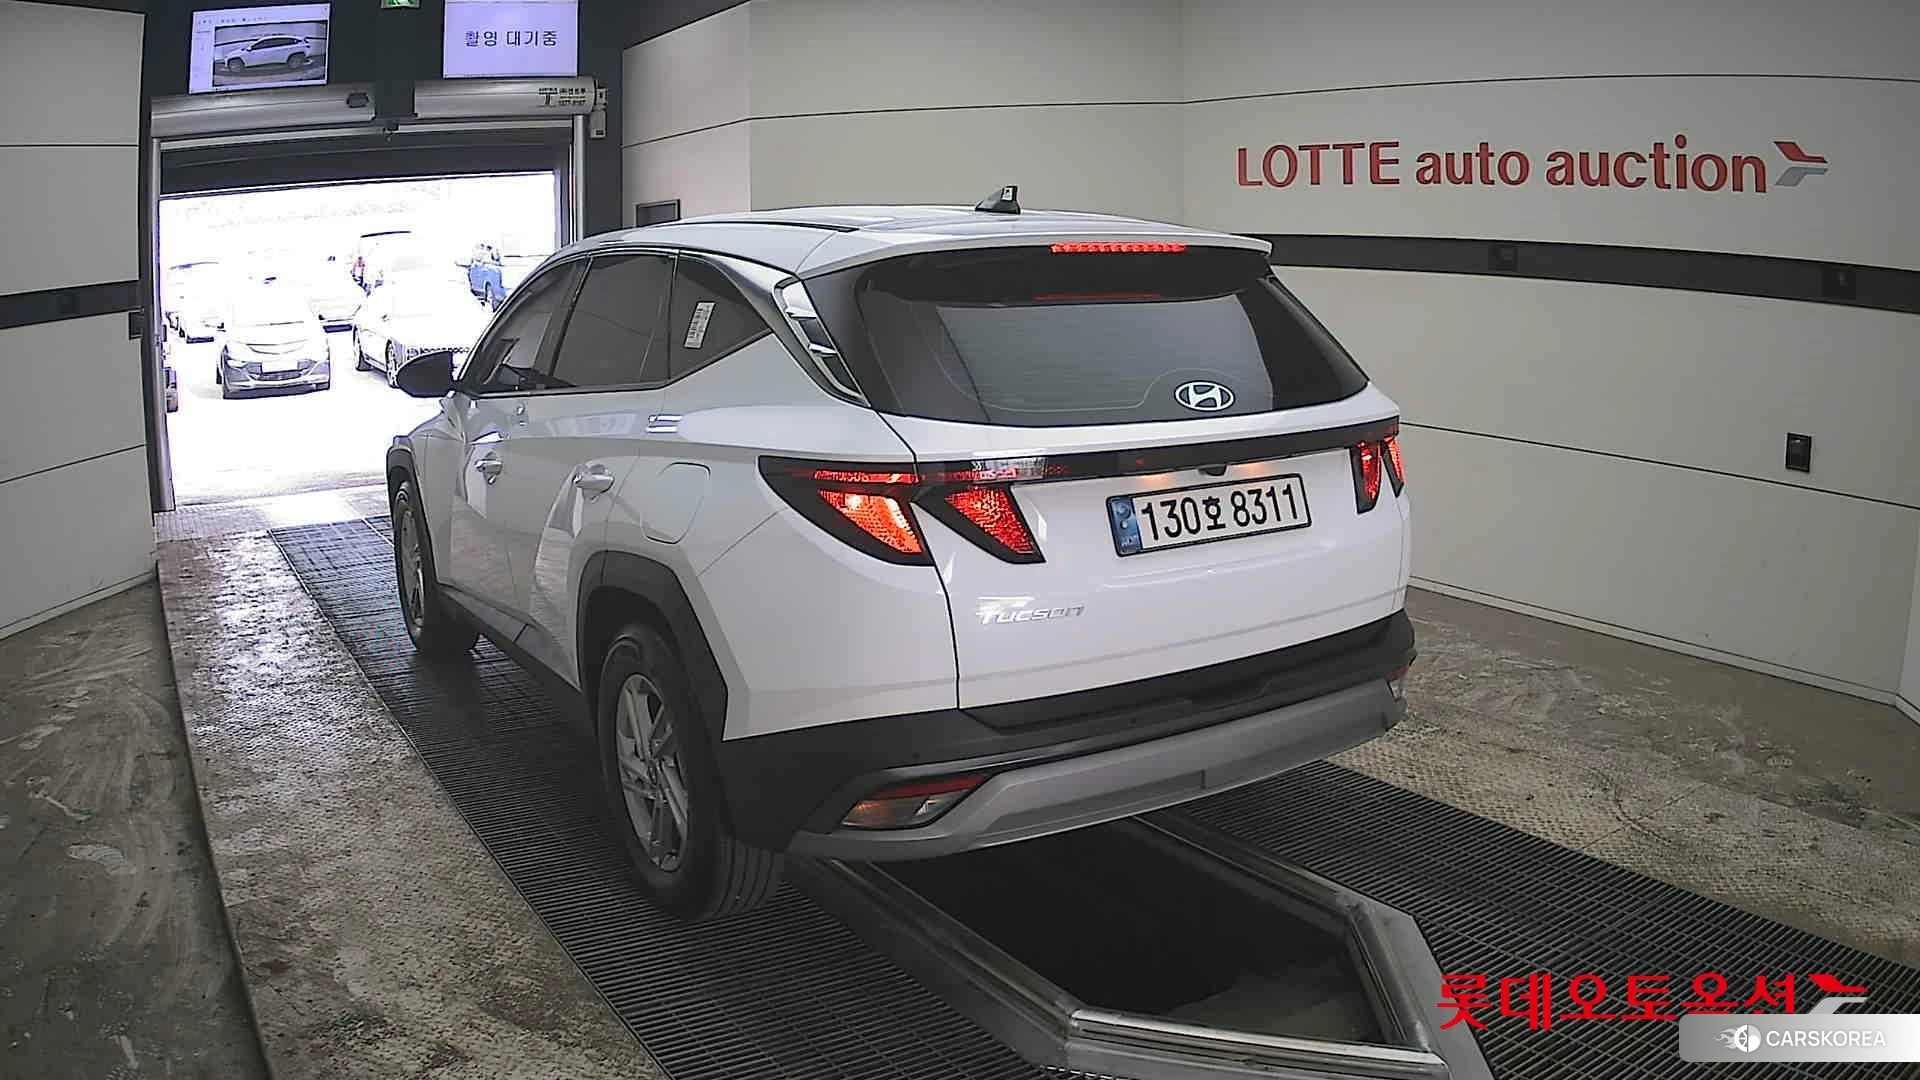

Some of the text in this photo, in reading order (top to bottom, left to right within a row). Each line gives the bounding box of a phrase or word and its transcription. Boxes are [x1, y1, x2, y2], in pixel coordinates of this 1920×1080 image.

[506, 30, 558, 47] 대기중
[1237, 134, 1767, 193] LOTTE auto auction
